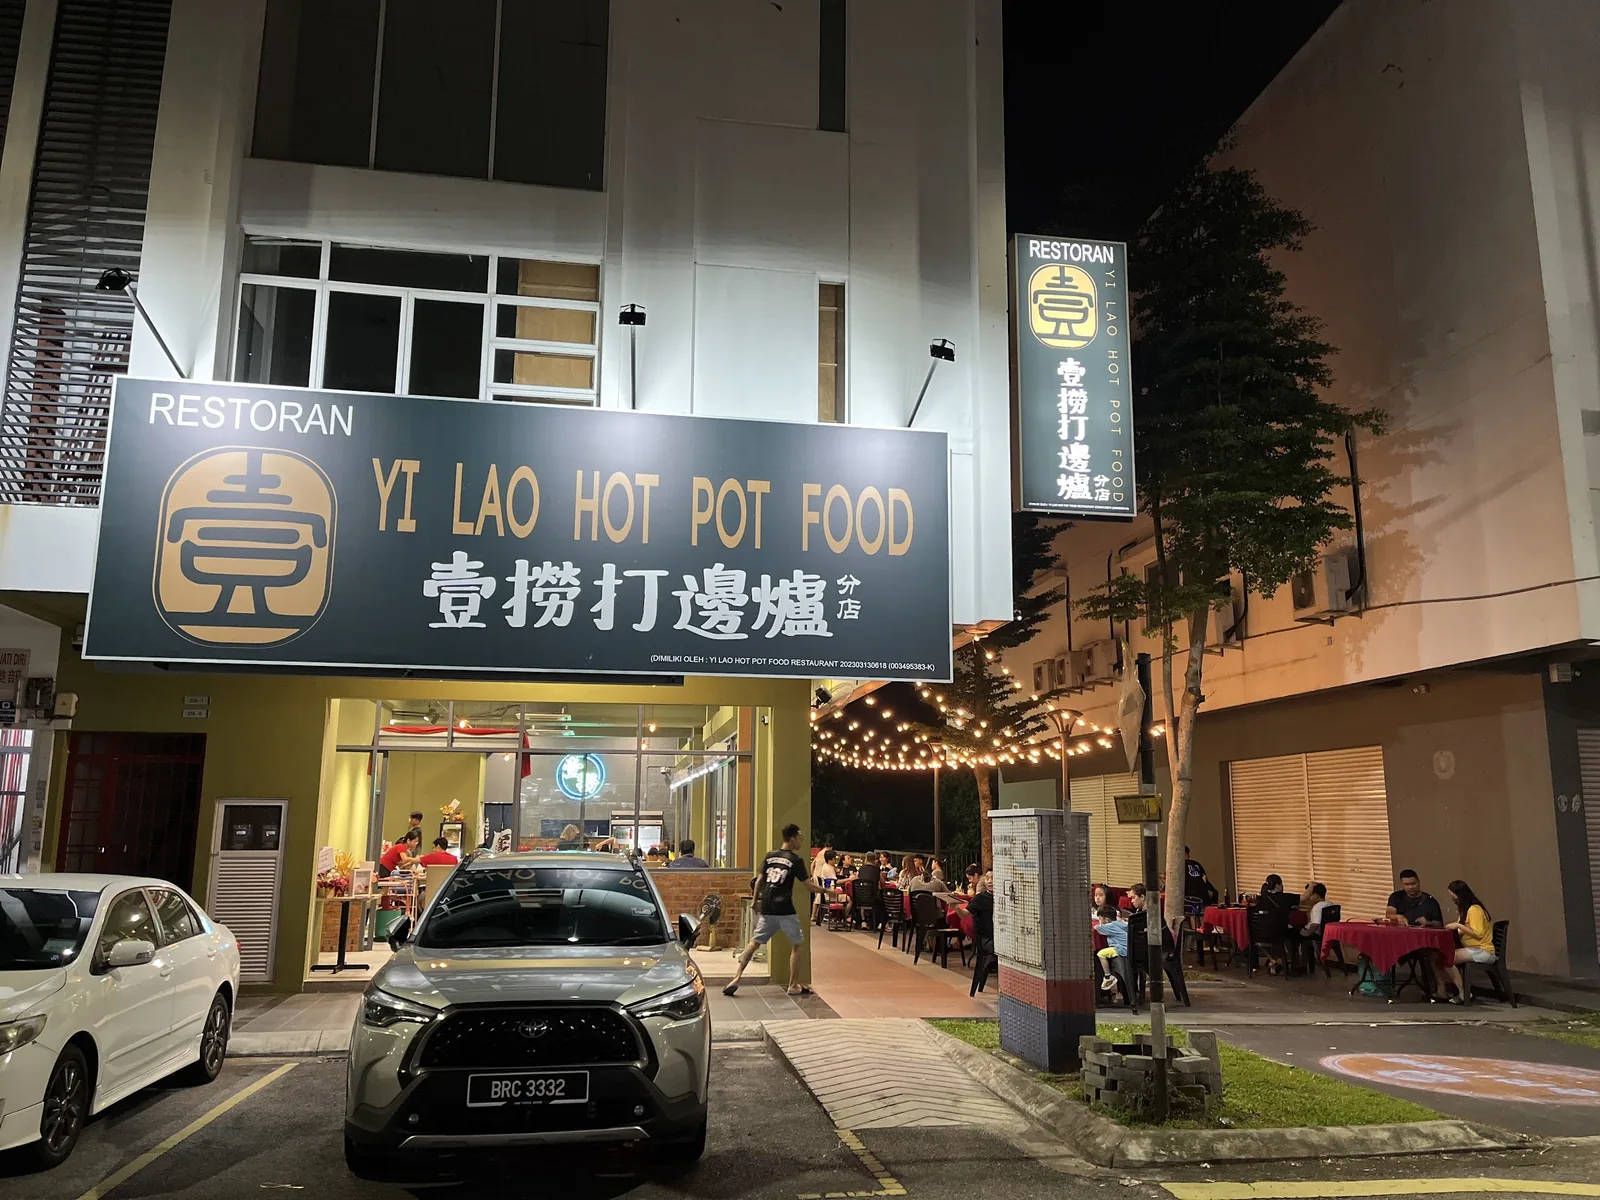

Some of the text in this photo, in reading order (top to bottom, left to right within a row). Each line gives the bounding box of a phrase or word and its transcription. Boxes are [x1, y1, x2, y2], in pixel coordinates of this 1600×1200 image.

[1029, 240, 1114, 264] RESTORAN
[1105, 269, 1124, 502] YI LAO HOT POT FOOD
[148, 391, 354, 437] RESTORAN
[372, 457, 914, 556] YI LAO HOT POT FOOD
[1093, 474, 1111, 502] 分店
[422, 551, 834, 640] 壹撈打邊爐
[836, 574, 862, 621] 分店
[650, 655, 682, 663] (DIMILIKI
[683, 655, 704, 663] OLEH
[709, 656, 717, 664] YI
[718, 656, 733, 664] LAO
[734, 657, 751, 665] HOT
[751, 657, 767, 665] POT
[768, 658, 790, 666] FOOD
[791, 658, 839, 667] RESTAURANT
[491, 1079, 566, 1099] BRC 3332
